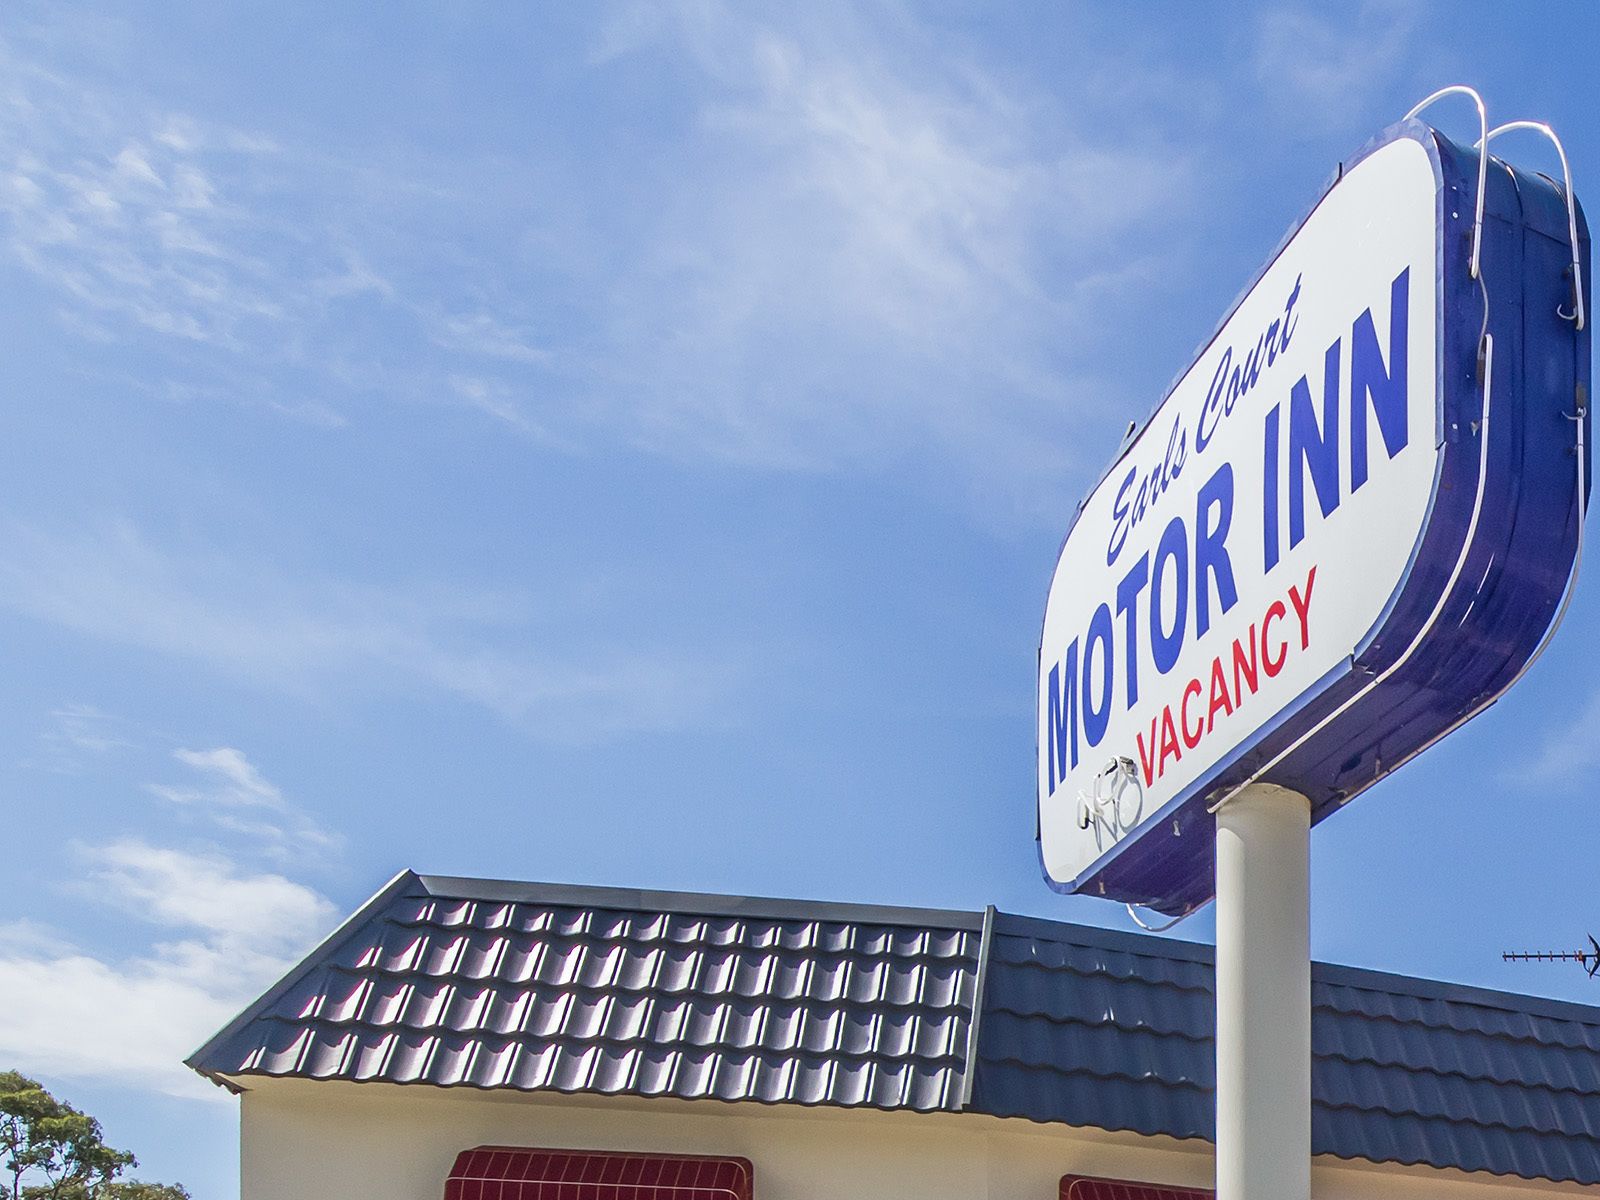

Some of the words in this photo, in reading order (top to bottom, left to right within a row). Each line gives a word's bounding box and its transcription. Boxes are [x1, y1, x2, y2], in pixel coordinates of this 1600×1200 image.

[1047, 461, 1238, 797] MOTOR
[1263, 265, 1410, 576] INN
[1107, 410, 1189, 569] Earls
[1195, 272, 1304, 454] Court
[1135, 565, 1318, 789] VACANCY
